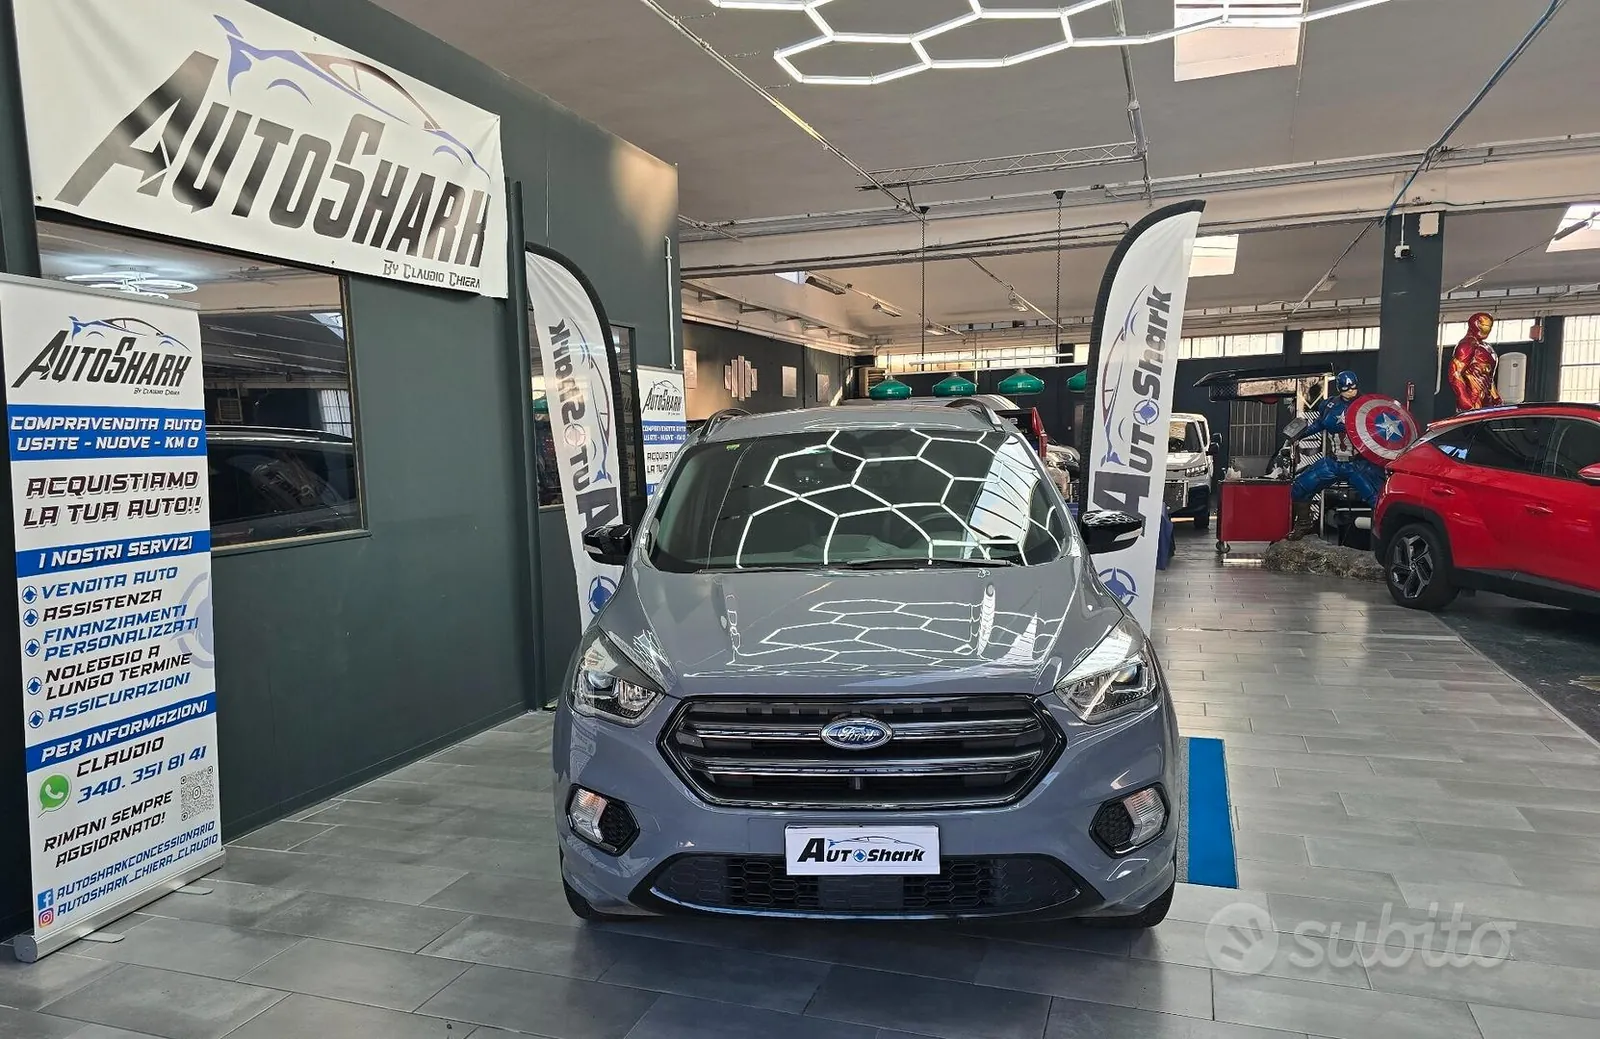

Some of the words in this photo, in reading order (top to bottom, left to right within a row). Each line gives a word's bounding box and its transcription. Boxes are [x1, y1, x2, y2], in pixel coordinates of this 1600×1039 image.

[11, 416, 159, 431] COMPRAVENDITA
[164, 418, 203, 431] AUTO
[17, 437, 80, 451] USATE
[96, 436, 150, 449] NUOVE
[165, 436, 185, 449] KM
[26, 471, 199, 499] ACQUISTIAMO
[23, 505, 60, 529] LA
[68, 501, 120, 525] TUA
[128, 495, 203, 519] AUTO!!
[39, 552, 46, 569] I
[51, 543, 124, 567] NOSTRI
[128, 535, 194, 557] SERVIZI
[41, 573, 127, 599] VENDITA
[133, 566, 179, 585] AUTO
[43, 588, 163, 622] ASSISTENZA
[43, 604, 188, 645] FINANZIAMENTI
[44, 617, 199, 662] PERSONALIZZATI
[45, 649, 143, 684] NOLEGGIO
[148, 645, 161, 659] A
[46, 676, 113, 700] LUNGO
[120, 652, 193, 682] TERMINE
[48, 671, 191, 722] ASSICURAZIONI
[40, 739, 83, 763] PER
[86, 699, 208, 749] INFORMAZIONI
[837, 725, 876, 742] Ford
[76, 736, 165, 778] CLAUDIO
[43, 816, 107, 853] RIMANI
[110, 790, 174, 826] SEMPRE
[55, 811, 166, 868] AGGIORNATO!
[56, 820, 216, 900] AUTOSHARKCONCESSIONARIO
